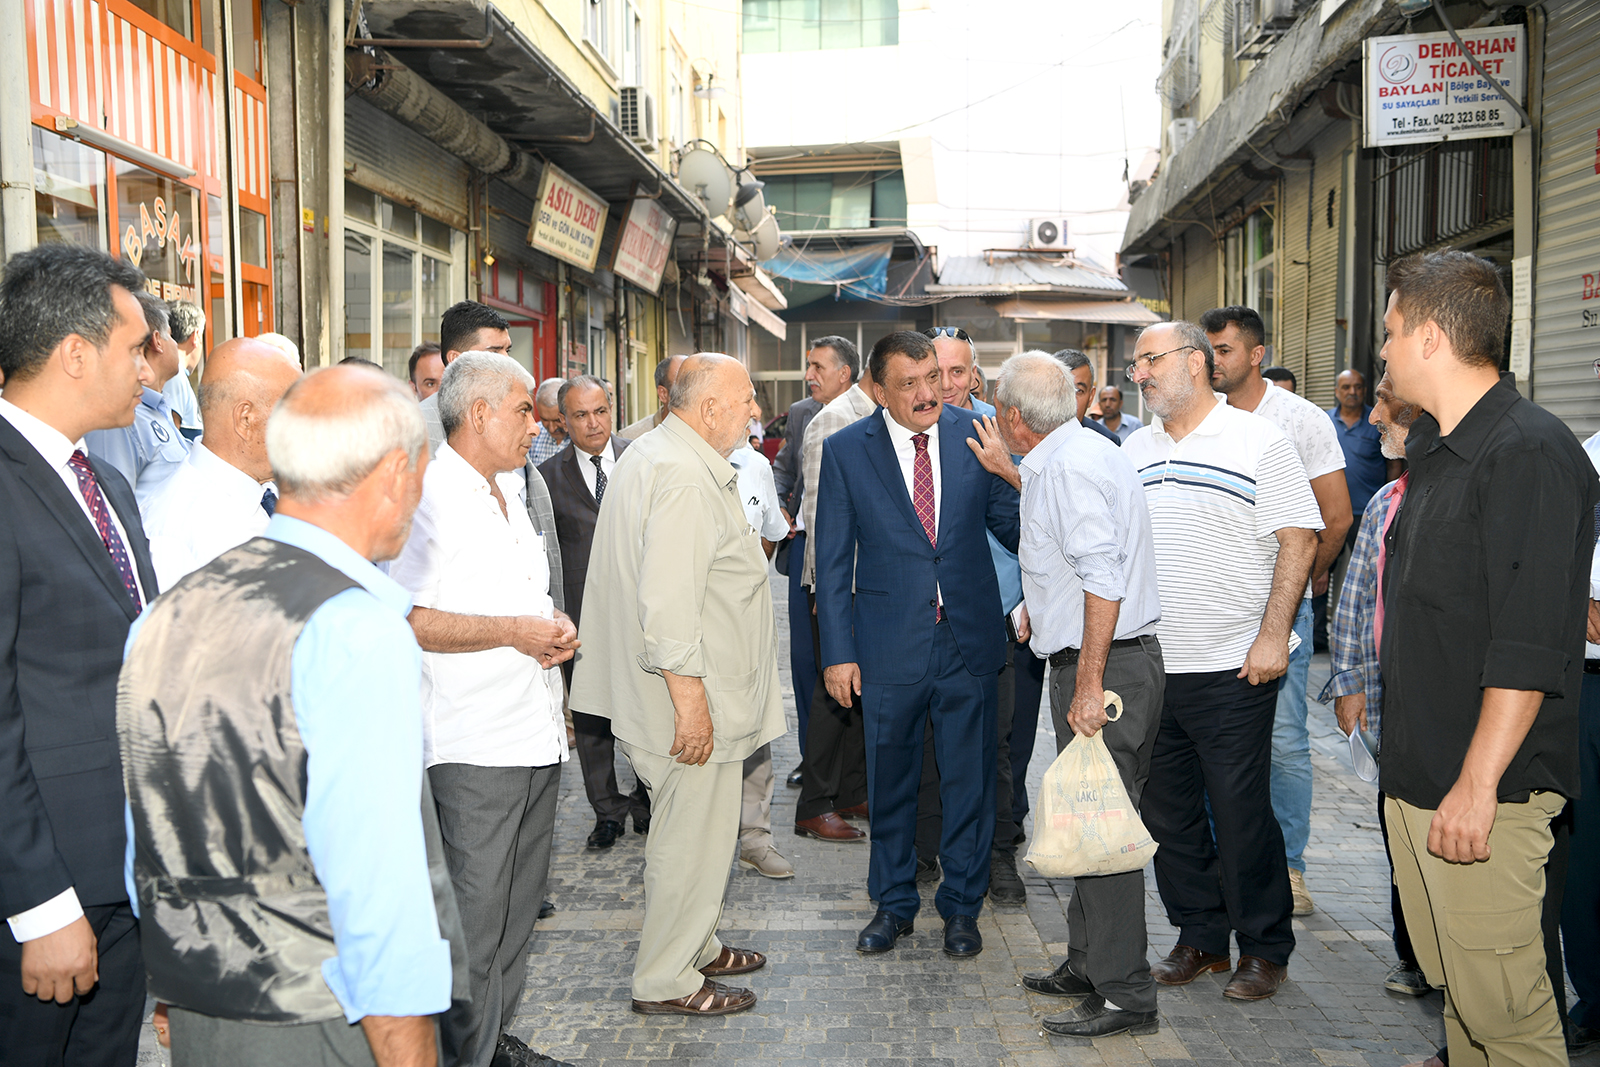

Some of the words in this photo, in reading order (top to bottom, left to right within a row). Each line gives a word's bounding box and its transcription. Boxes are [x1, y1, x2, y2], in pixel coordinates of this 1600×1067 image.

[1418, 37, 1516, 58] DEMİRHAN
[1379, 82, 1443, 98] BAYLAN
[1450, 81, 1474, 92] Bölge
[1500, 78, 1510, 87] ve
[1382, 102, 1393, 110] SU
[1396, 98, 1440, 109] SAYAÇLARI
[1454, 94, 1478, 104] Yetkili
[1392, 117, 1406, 129] Tel
[1413, 116, 1431, 128] Fax.
[1434, 112, 1454, 125] 0422
[1458, 111, 1473, 123] 323
[1476, 110, 1486, 122] 68
[1488, 109, 1500, 120] 85
[544, 182, 574, 218] ASİL
[574, 198, 602, 233] DERİ
[124, 196, 196, 283] BAŞAK
[1582, 309, 1598, 328] Su
